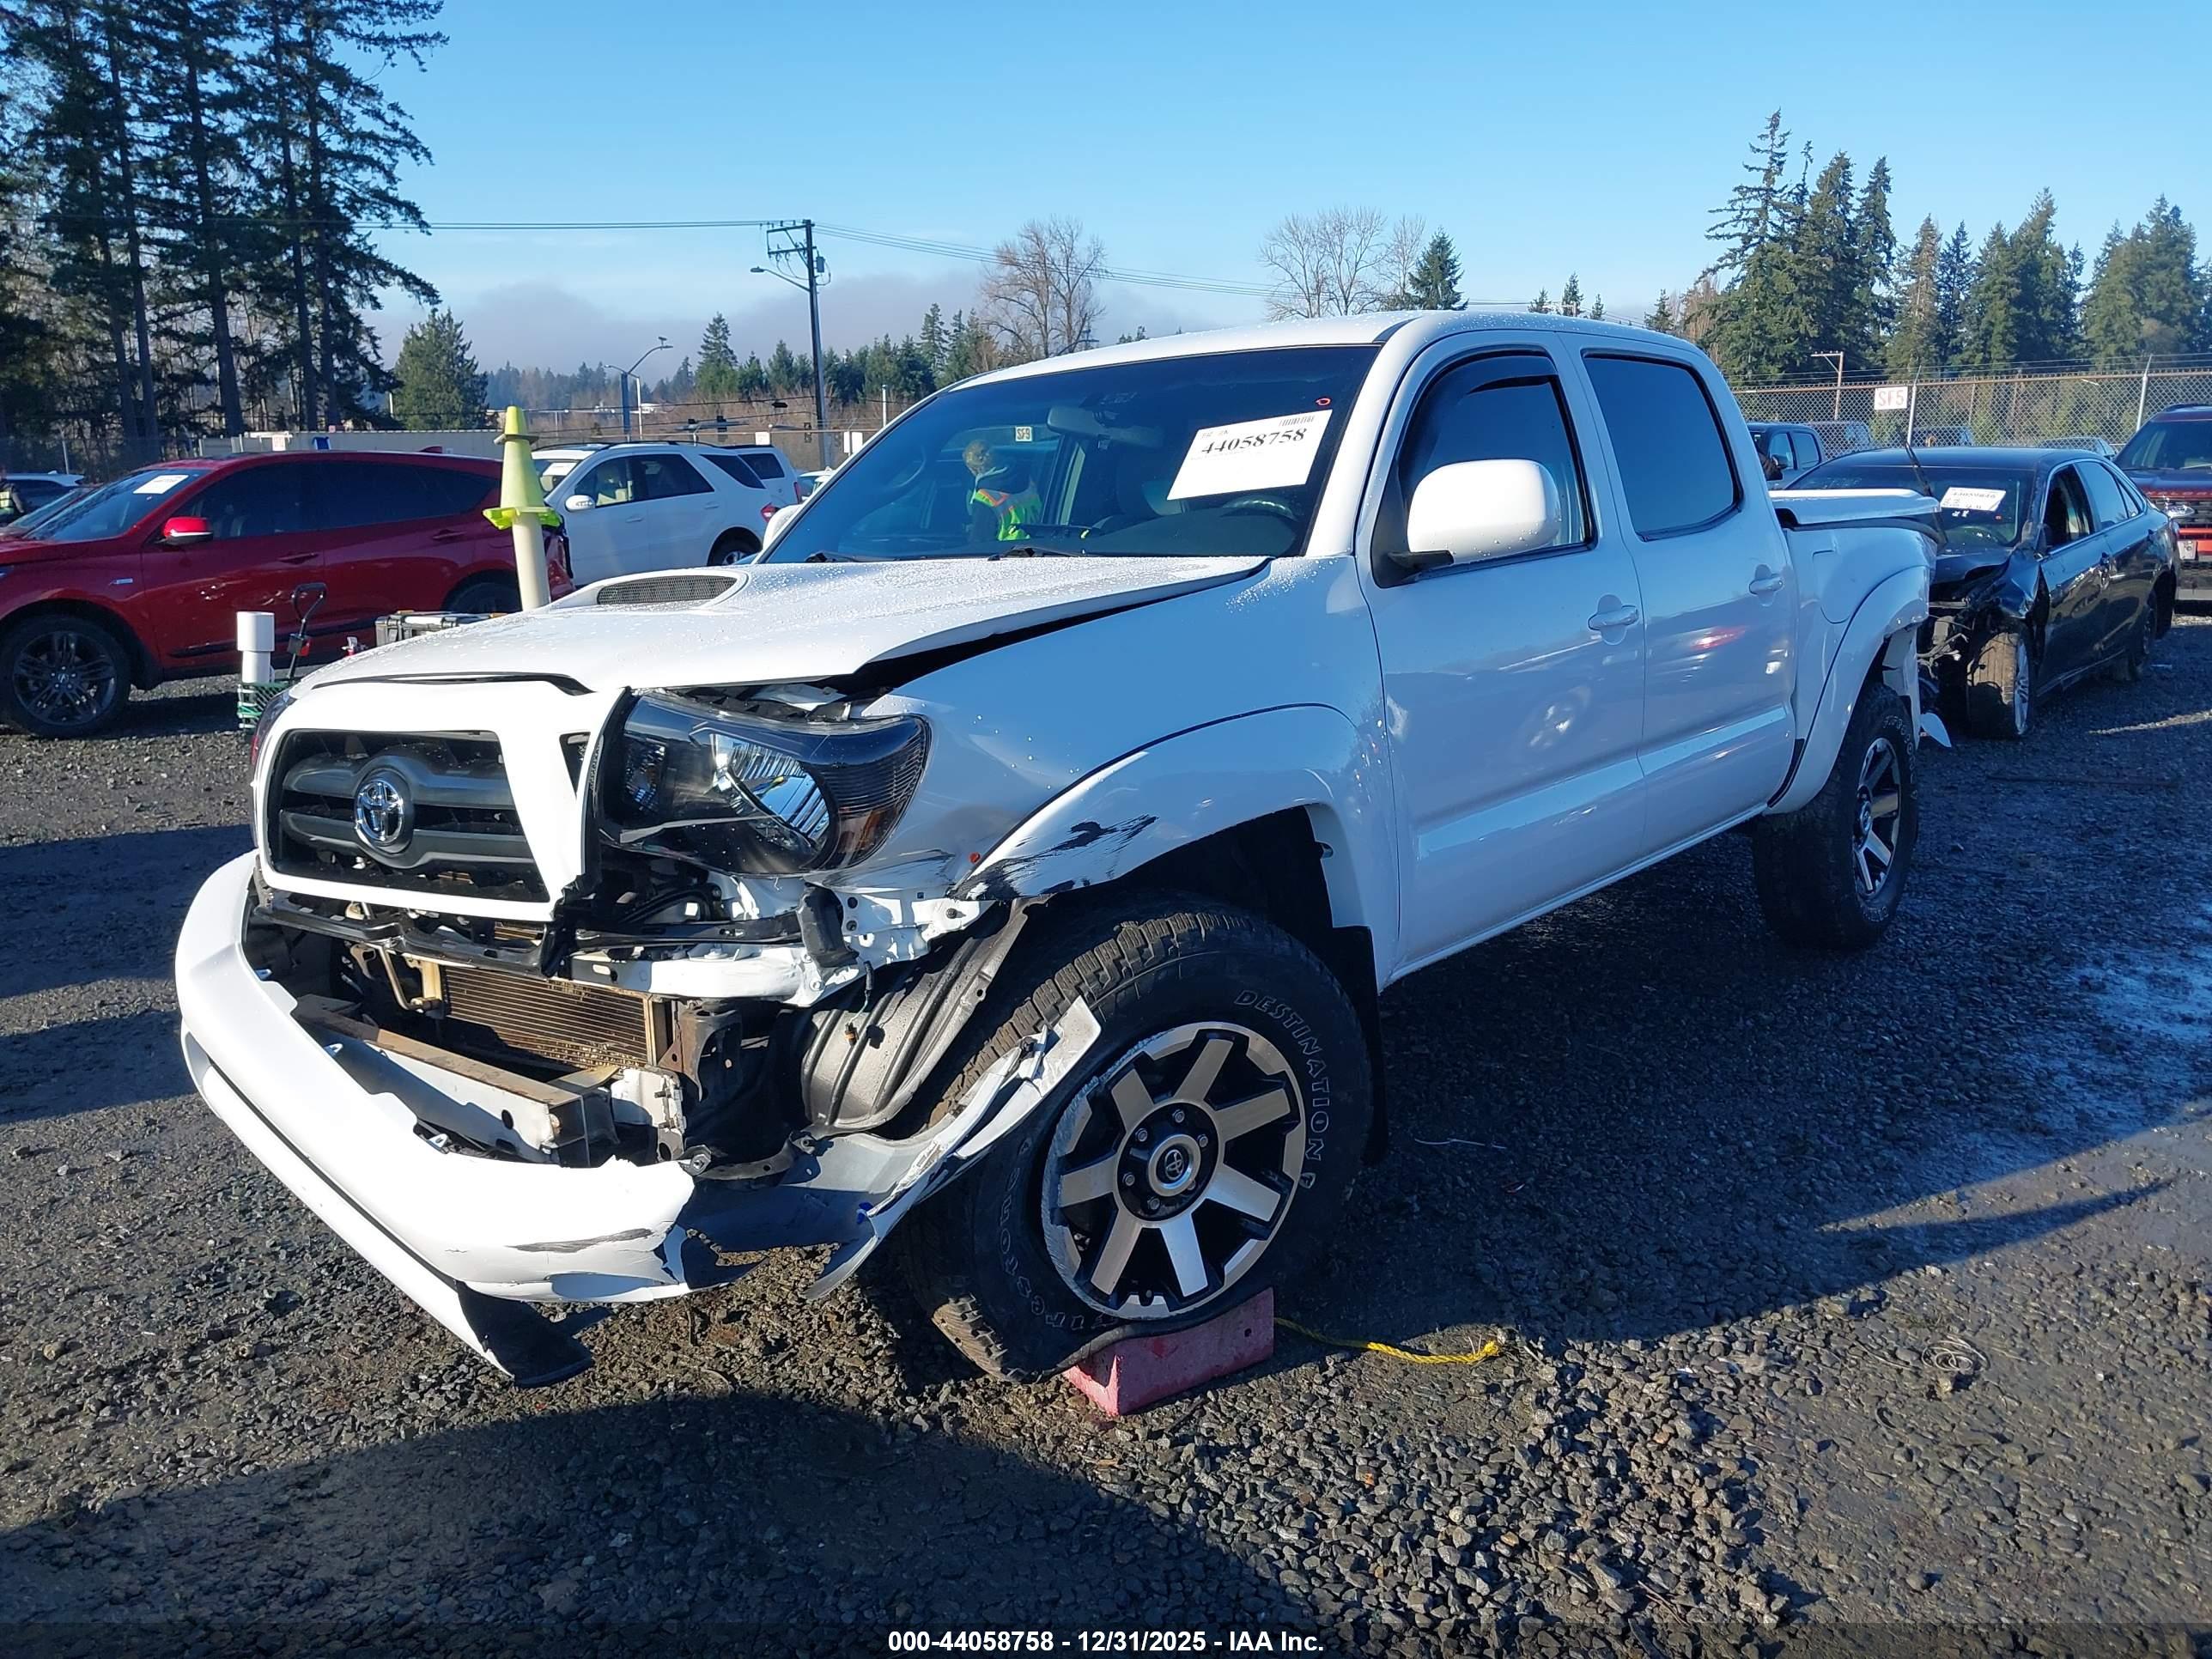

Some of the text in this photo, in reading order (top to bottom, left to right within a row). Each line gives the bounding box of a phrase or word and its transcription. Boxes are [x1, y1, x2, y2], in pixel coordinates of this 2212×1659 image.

[1878, 390, 1905, 406] SF5
[1201, 428, 1308, 454] 44058758
[1233, 989, 1330, 1161] DESTINATION
